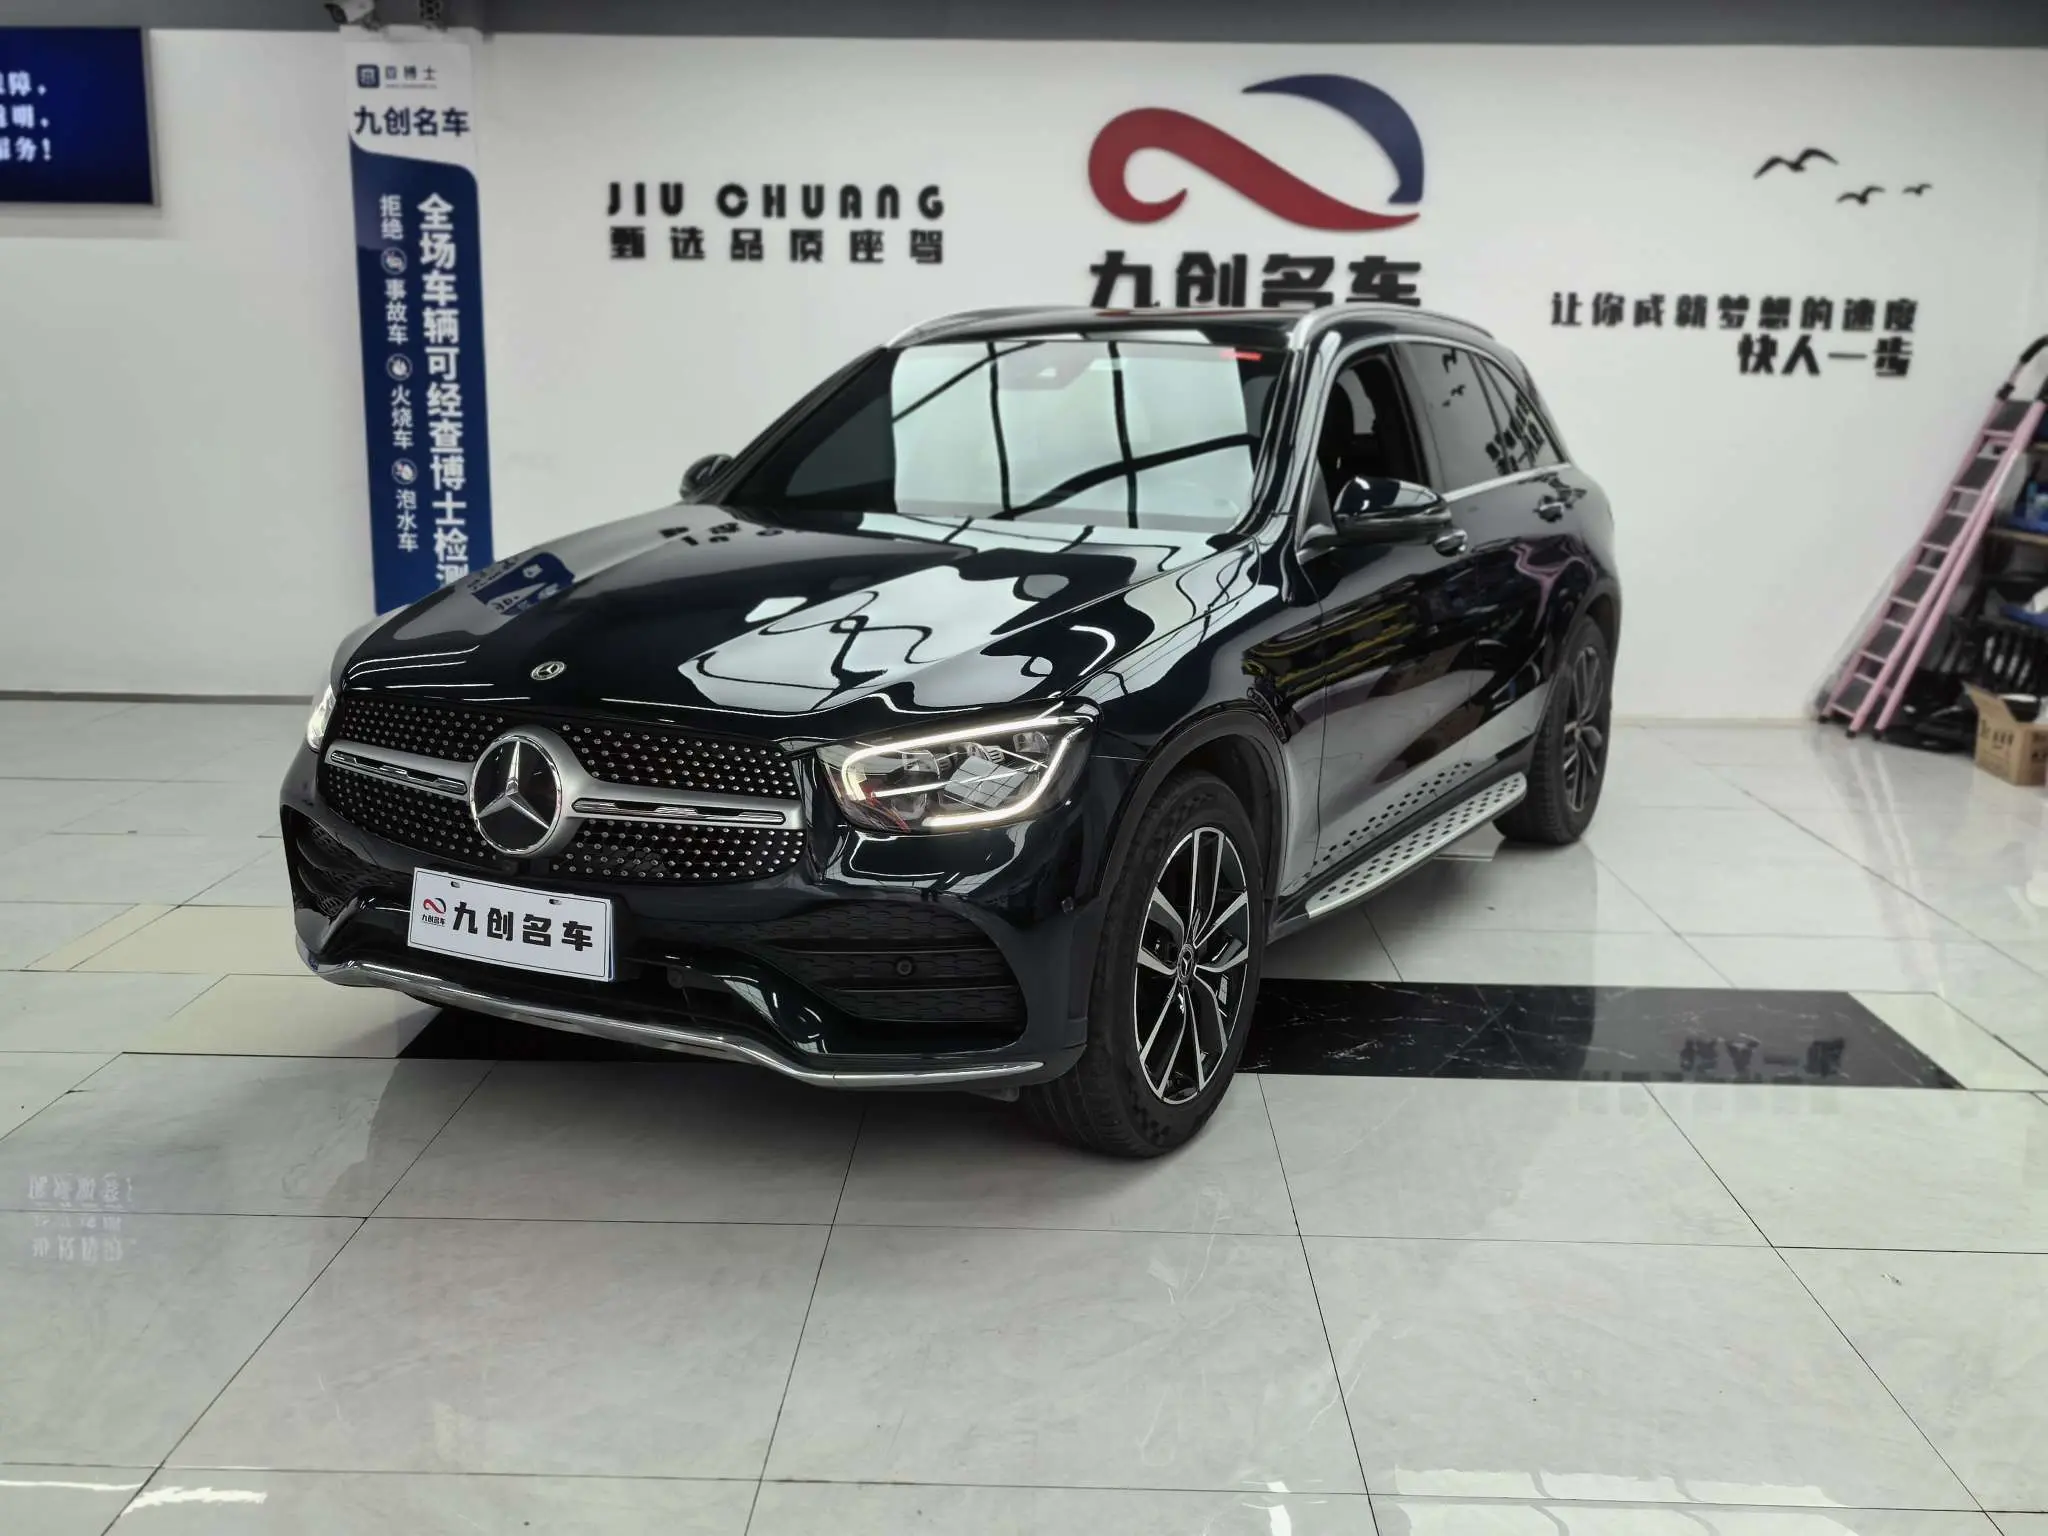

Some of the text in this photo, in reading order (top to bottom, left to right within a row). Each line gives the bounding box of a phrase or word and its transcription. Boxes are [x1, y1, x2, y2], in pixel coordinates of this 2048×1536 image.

[354, 106, 470, 137] 九创名车
[608, 182, 944, 219] JIU CHUANG
[609, 226, 943, 264] 甄选品质座驾
[1090, 250, 1421, 309] 九创名车
[1551, 293, 1918, 332] 让你成就梦想的速度
[380, 194, 419, 552] 拒绝 事故车 火烧车 泡水车
[1737, 334, 1913, 378] 快人一步
[453, 901, 593, 951] 九创名车
